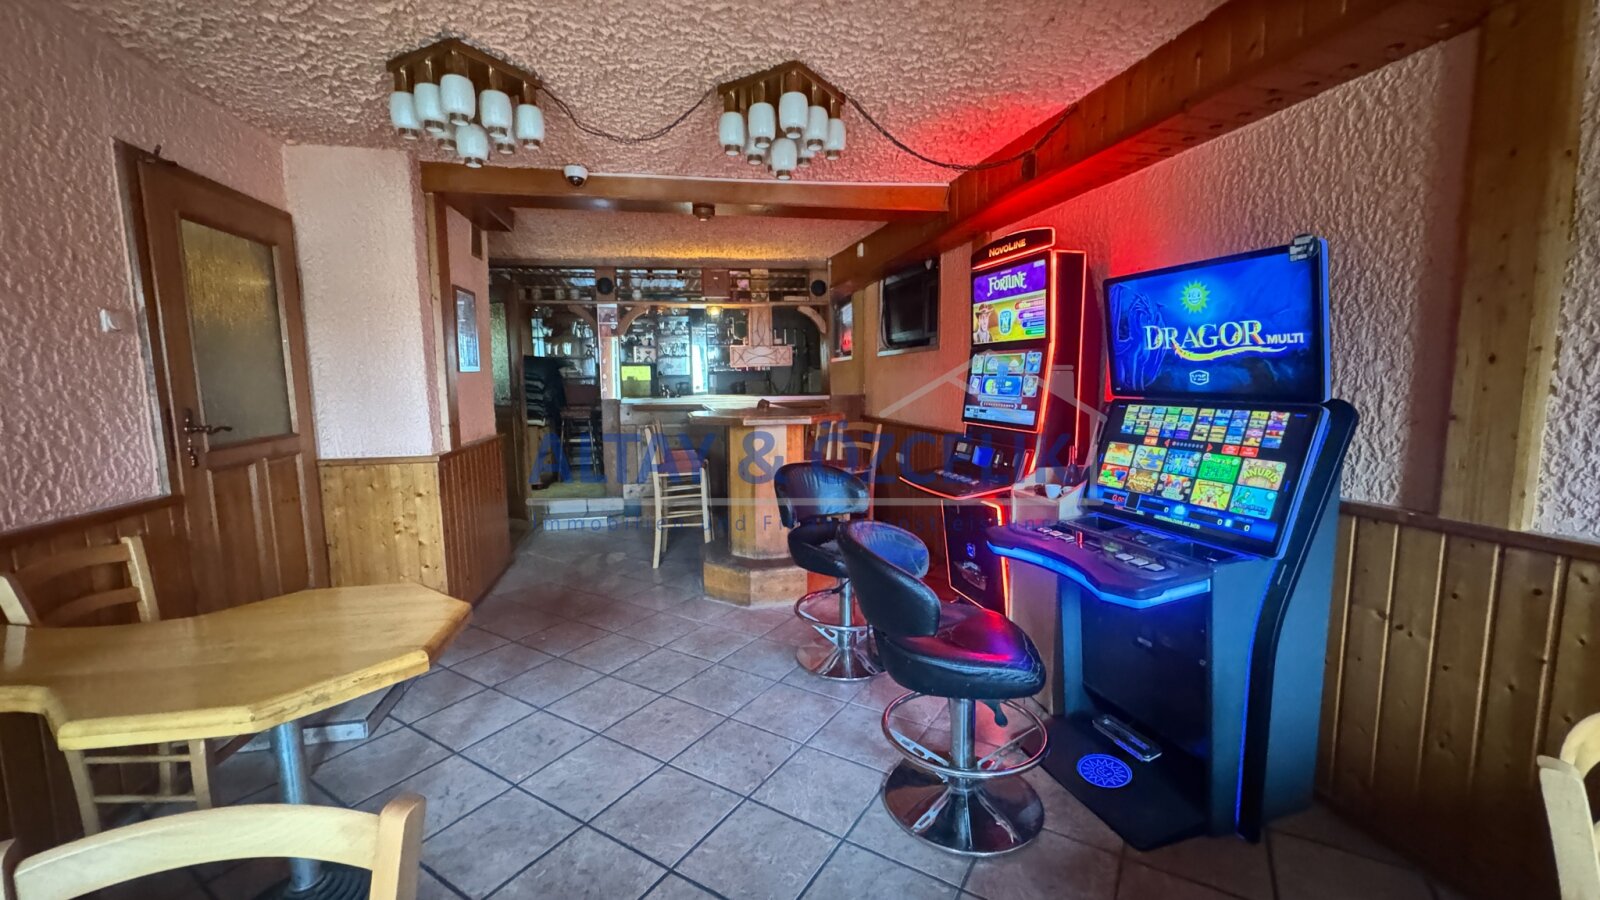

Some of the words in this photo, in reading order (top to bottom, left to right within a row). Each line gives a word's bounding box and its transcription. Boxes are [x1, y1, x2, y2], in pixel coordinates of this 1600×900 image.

[987, 271, 1028, 297] FORTUNE
[1143, 320, 1266, 351] DRAGOR
[1266, 332, 1304, 345] MULTI
[1243, 467, 1280, 483] ANURIS
[1243, 524, 1250, 532] 0
